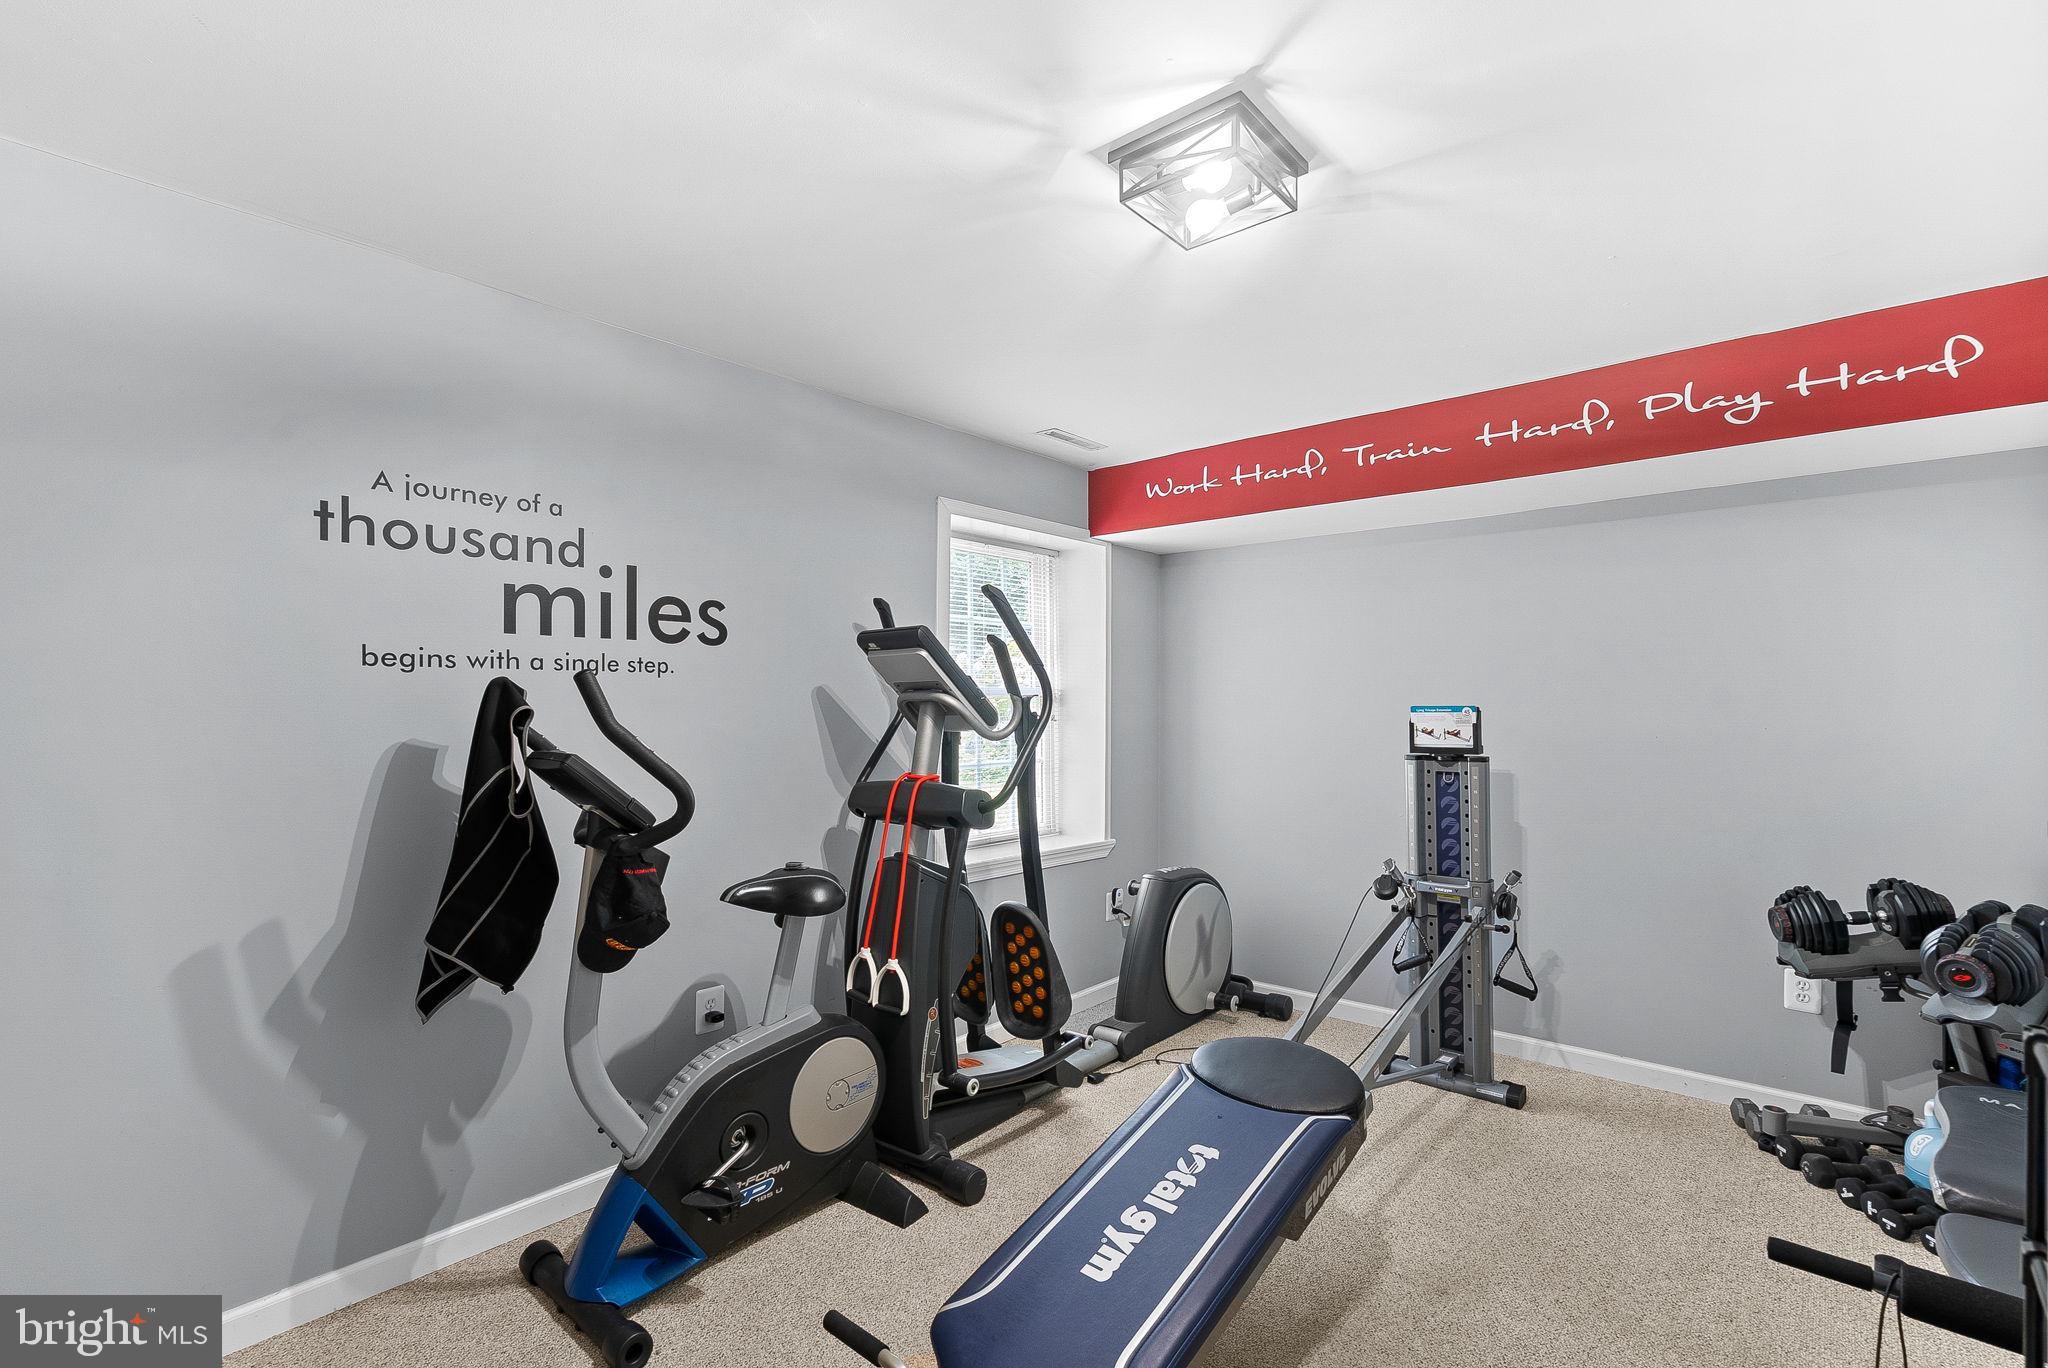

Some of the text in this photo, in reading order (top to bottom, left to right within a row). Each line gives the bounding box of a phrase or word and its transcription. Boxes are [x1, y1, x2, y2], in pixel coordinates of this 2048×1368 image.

[1146, 334, 1984, 501] Work Hard, Train Hard, Play Hard
[371, 470, 562, 517] A journey of a
[313, 496, 585, 568] thousand
[504, 565, 728, 646] miles
[361, 645, 674, 678] begins with a single step.
[1304, 1146, 1346, 1220] EVOLVE
[1080, 1205, 1156, 1282] gym
